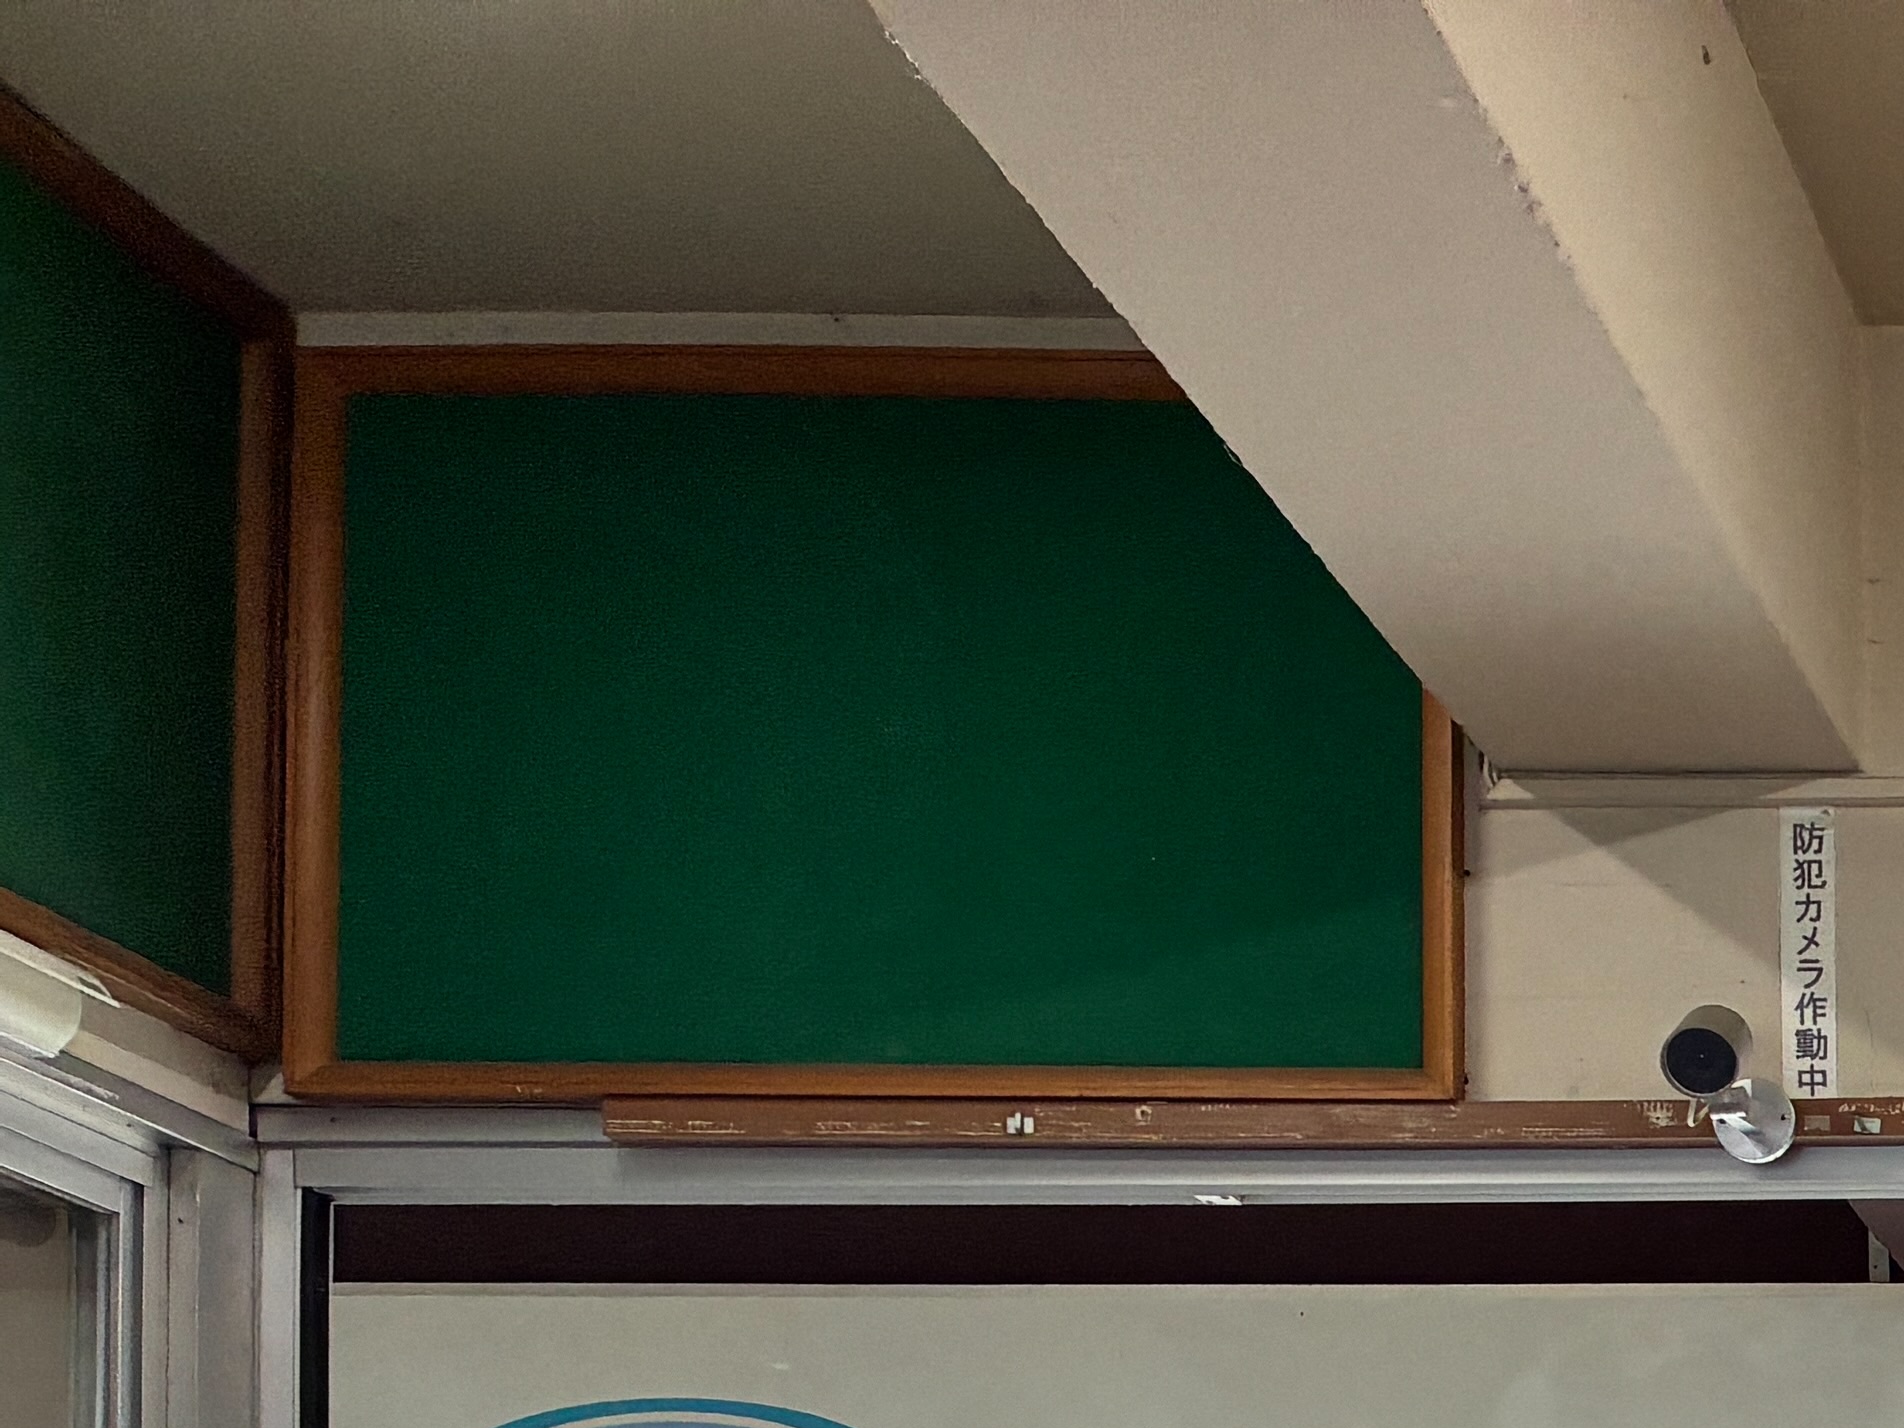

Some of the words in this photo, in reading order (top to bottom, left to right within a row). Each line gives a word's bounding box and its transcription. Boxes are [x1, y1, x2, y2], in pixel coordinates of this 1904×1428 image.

[1793, 822, 1828, 1097] 防犯カメラ作動中
